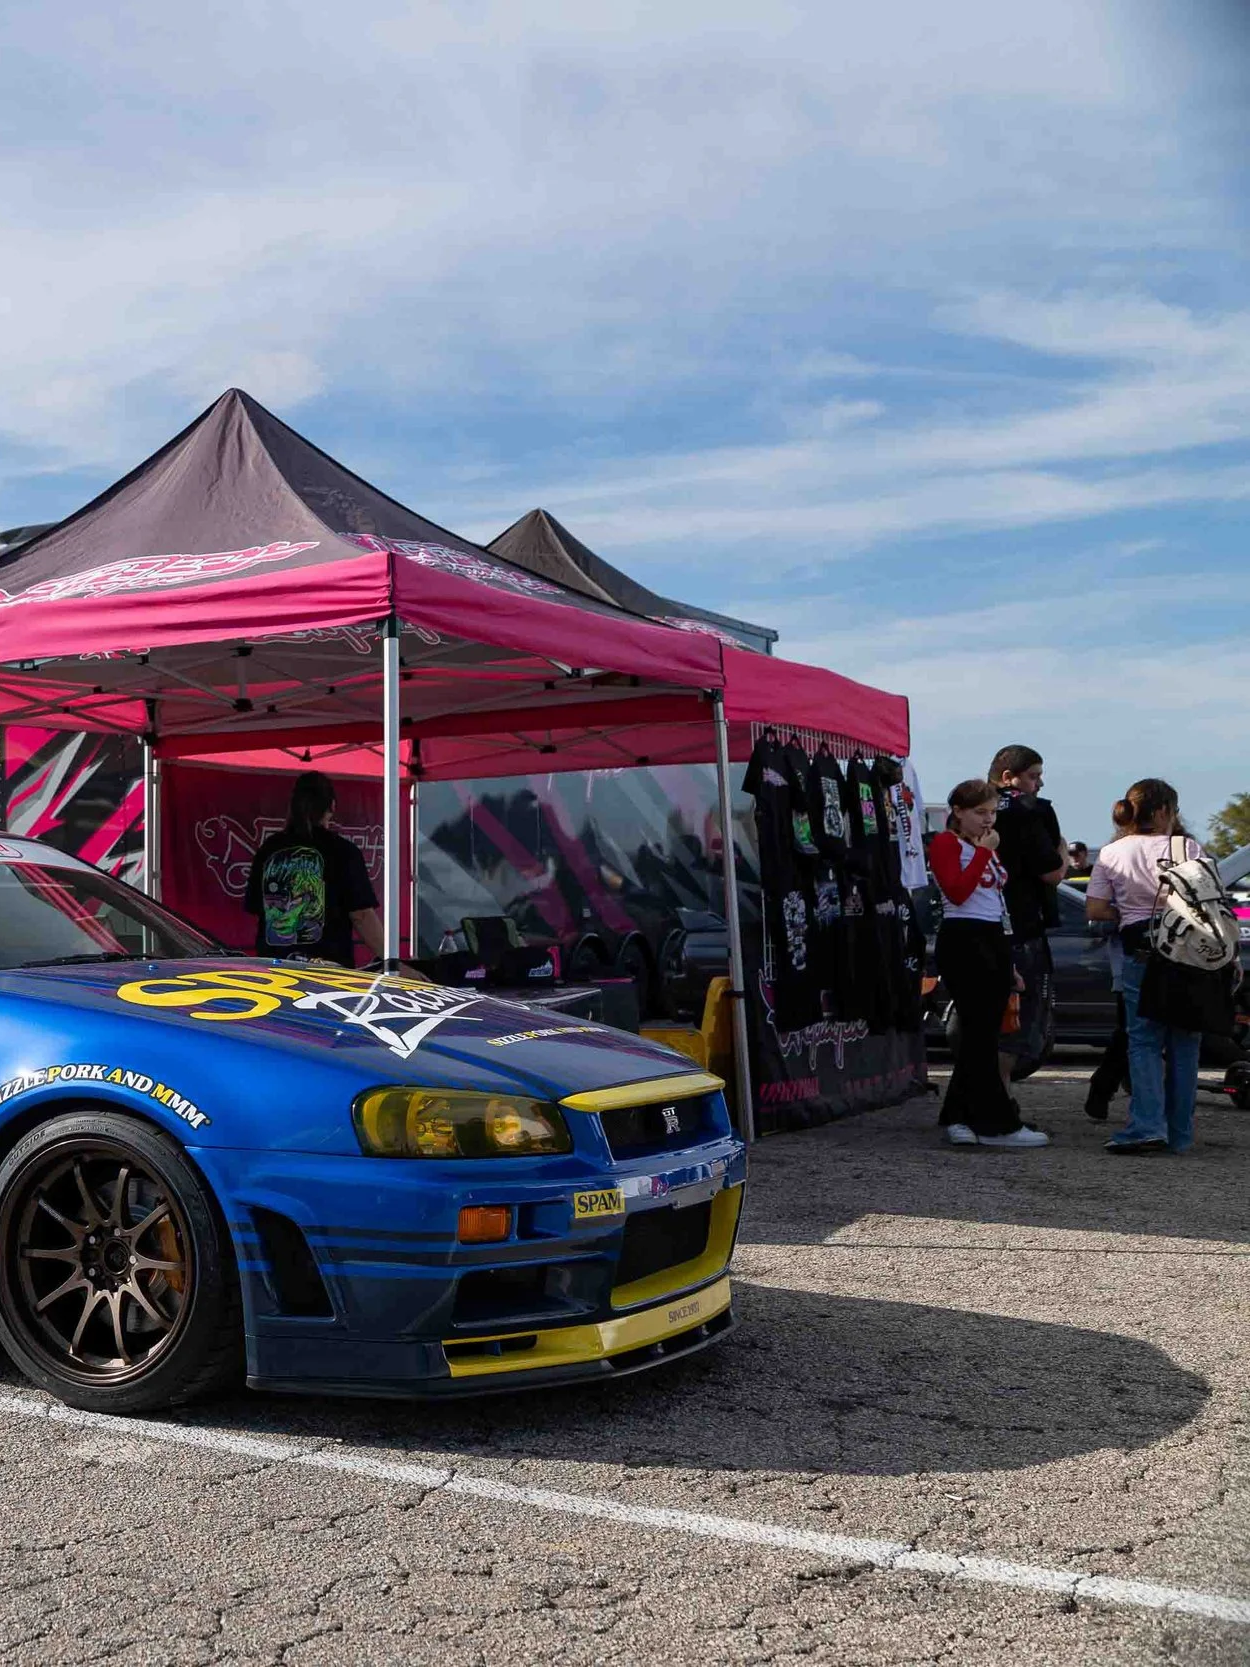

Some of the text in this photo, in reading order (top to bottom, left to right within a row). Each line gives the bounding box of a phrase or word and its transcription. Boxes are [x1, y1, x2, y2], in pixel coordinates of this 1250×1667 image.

[46, 1064, 108, 1083] PORK
[107, 1068, 153, 1093] AND
[7, 1128, 48, 1167] OUTSIDE
[577, 1191, 621, 1214] SPAM
[668, 1306, 688, 1323] SINCE
